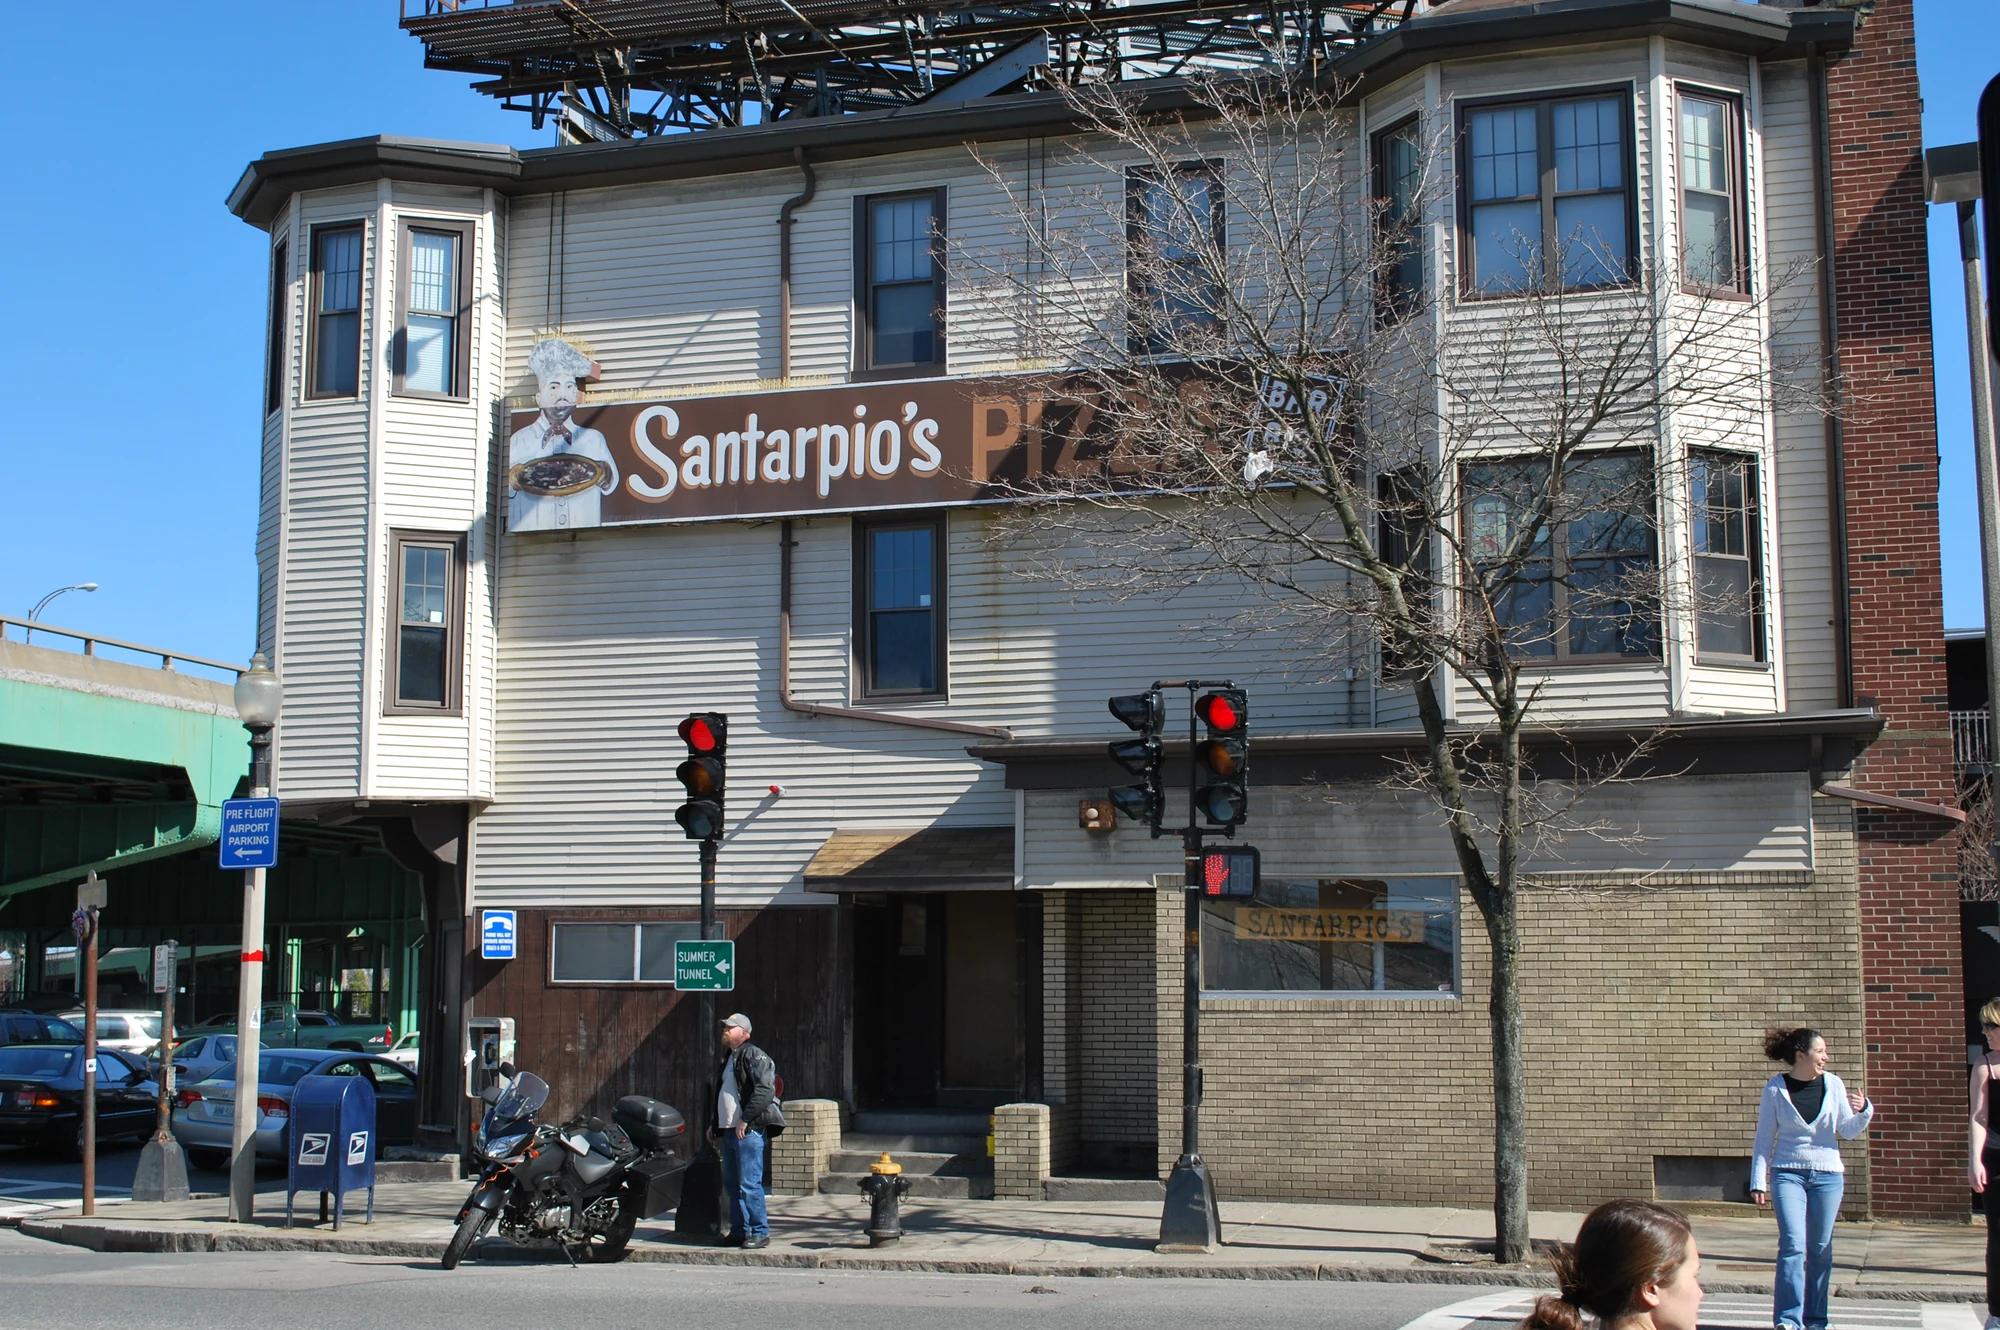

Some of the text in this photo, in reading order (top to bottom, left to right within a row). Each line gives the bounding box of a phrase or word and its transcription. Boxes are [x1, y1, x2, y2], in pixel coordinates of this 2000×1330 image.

[625, 401, 942, 503] Santarpio's
[226, 807, 274, 820] PRE FLIGHT
[228, 823, 270, 834] AIRPORT
[228, 835, 270, 846] PARKING
[1247, 910, 1413, 940] SANTARPIO'S
[678, 951, 716, 962] SUMNER
[678, 968, 713, 980] TUNNEL
